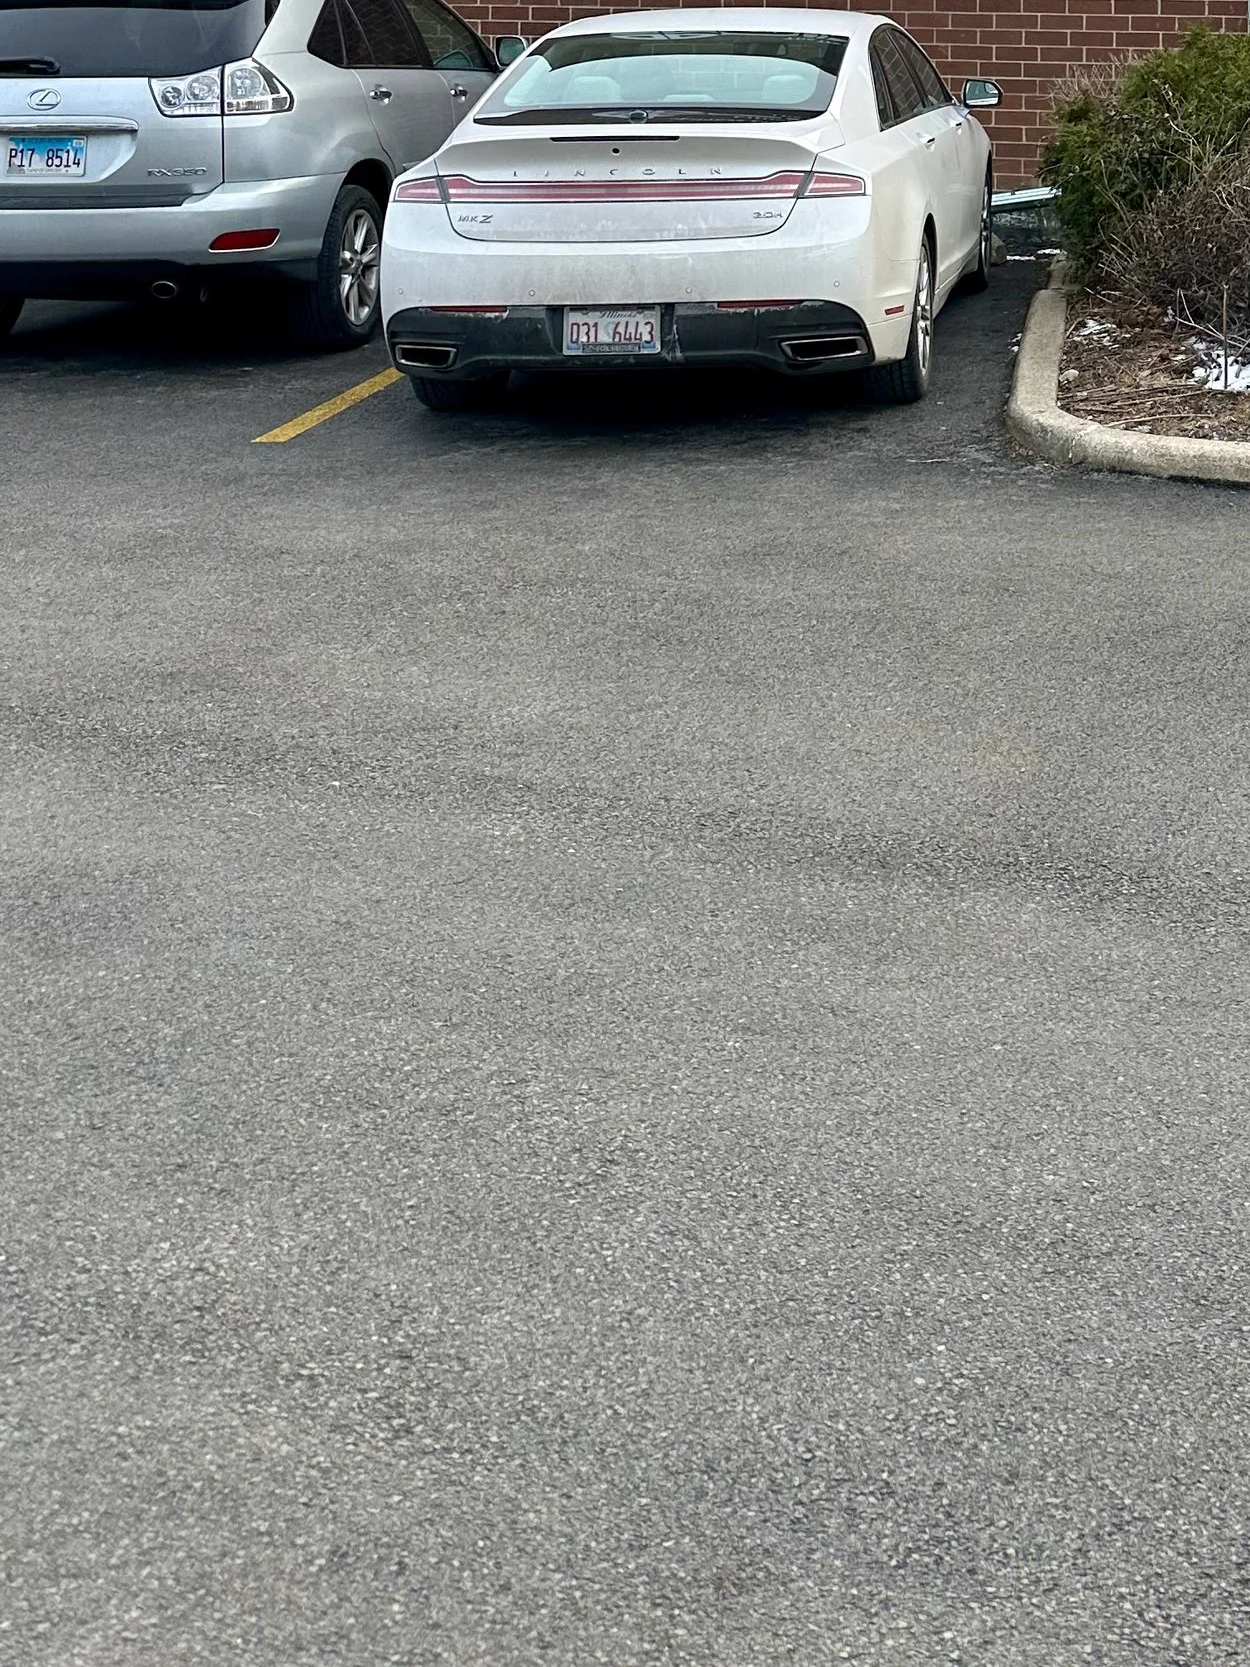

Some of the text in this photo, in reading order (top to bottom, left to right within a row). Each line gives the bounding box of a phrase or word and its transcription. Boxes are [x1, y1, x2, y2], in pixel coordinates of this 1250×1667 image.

[8, 148, 81, 168] P17 8514
[513, 167, 722, 177] LINCOLN
[457, 214, 494, 224] MKZ
[612, 320, 655, 344] 6443
